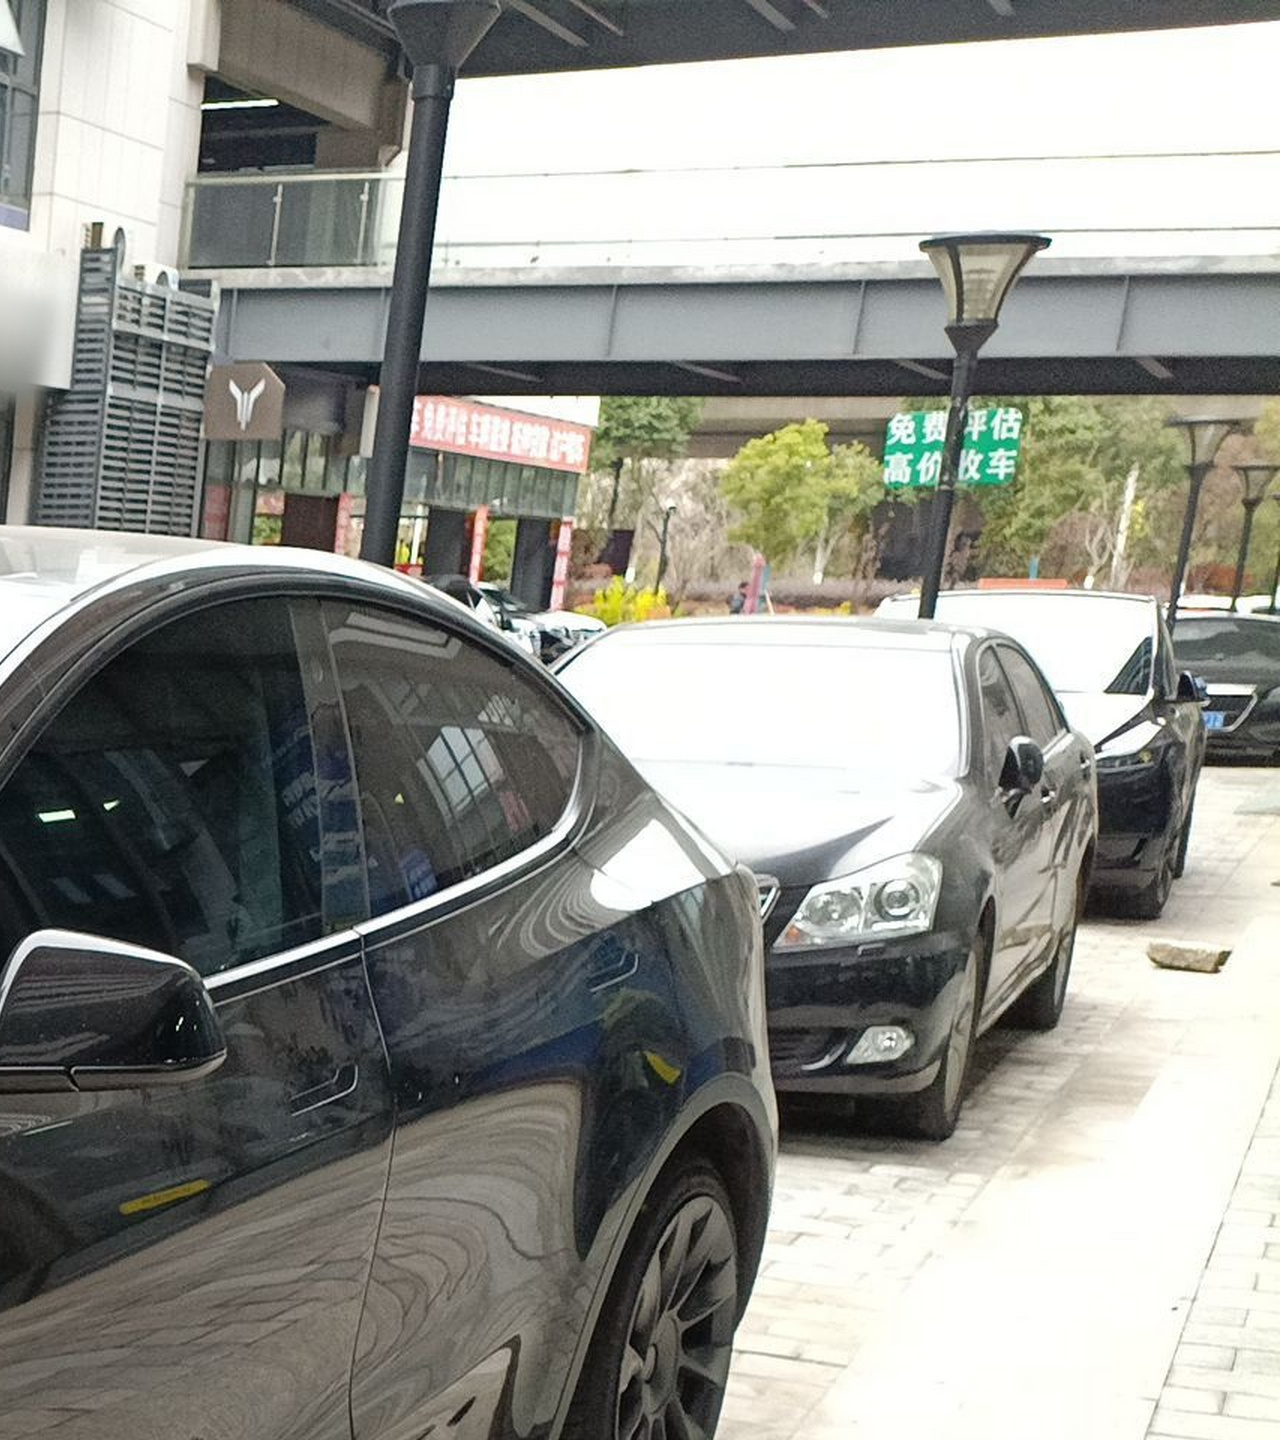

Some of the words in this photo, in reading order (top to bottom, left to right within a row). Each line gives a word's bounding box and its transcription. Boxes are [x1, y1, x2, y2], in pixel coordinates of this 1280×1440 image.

[886, 408, 1023, 446] 免费评估
[882, 447, 1018, 485] 高价收车
